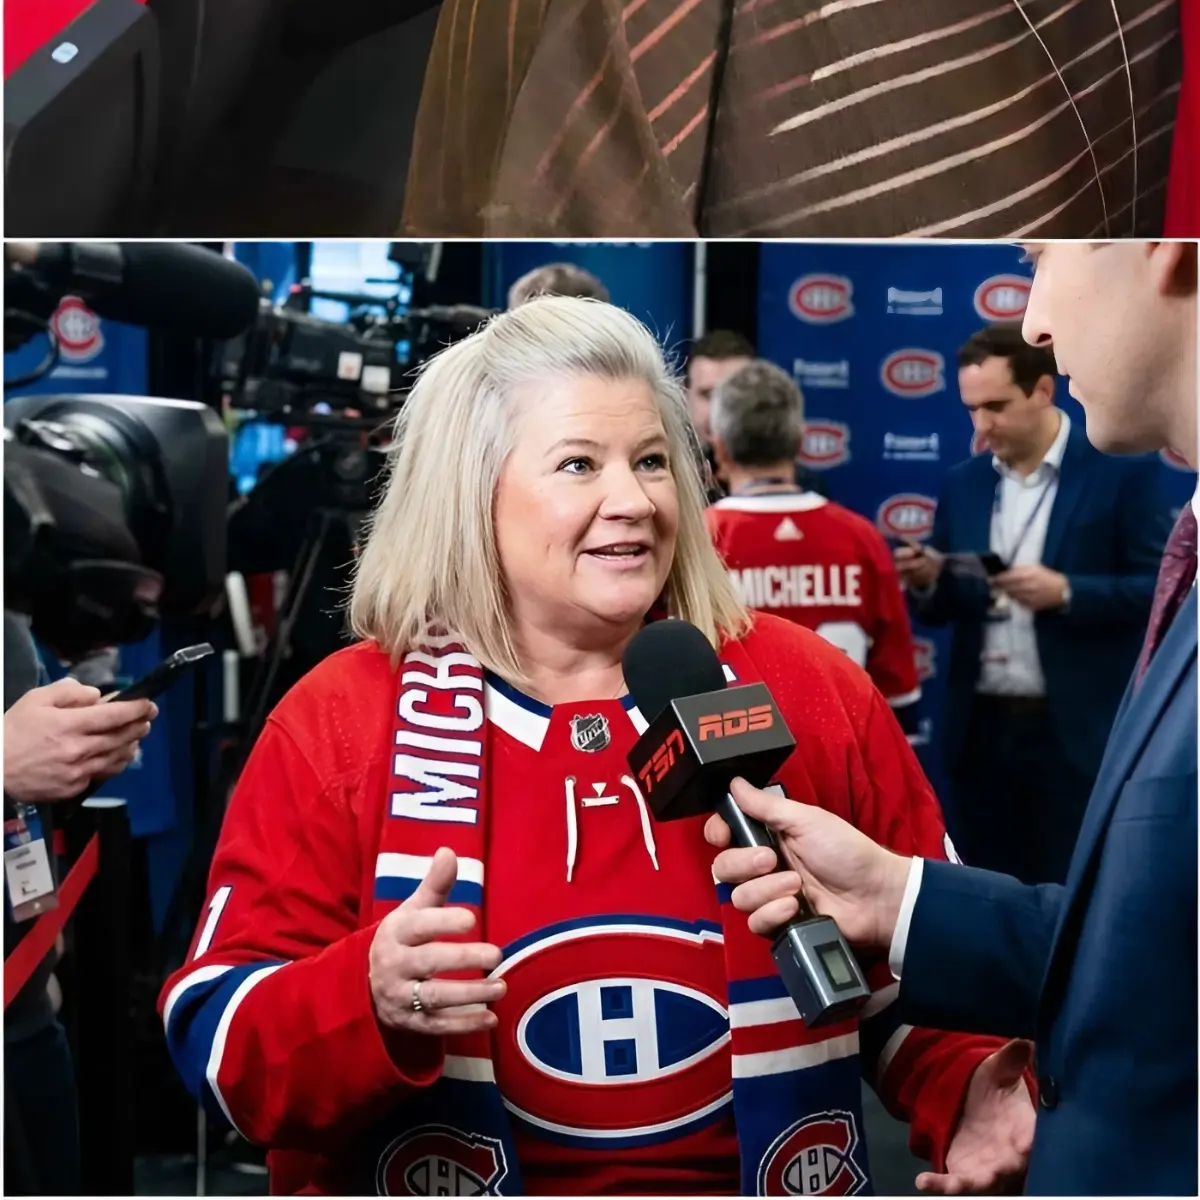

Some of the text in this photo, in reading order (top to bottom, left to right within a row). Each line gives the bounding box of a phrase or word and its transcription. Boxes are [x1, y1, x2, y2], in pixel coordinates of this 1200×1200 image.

[728, 564, 862, 608] MICHELLE
[698, 704, 774, 741] RDS
[638, 729, 685, 793] TSN
